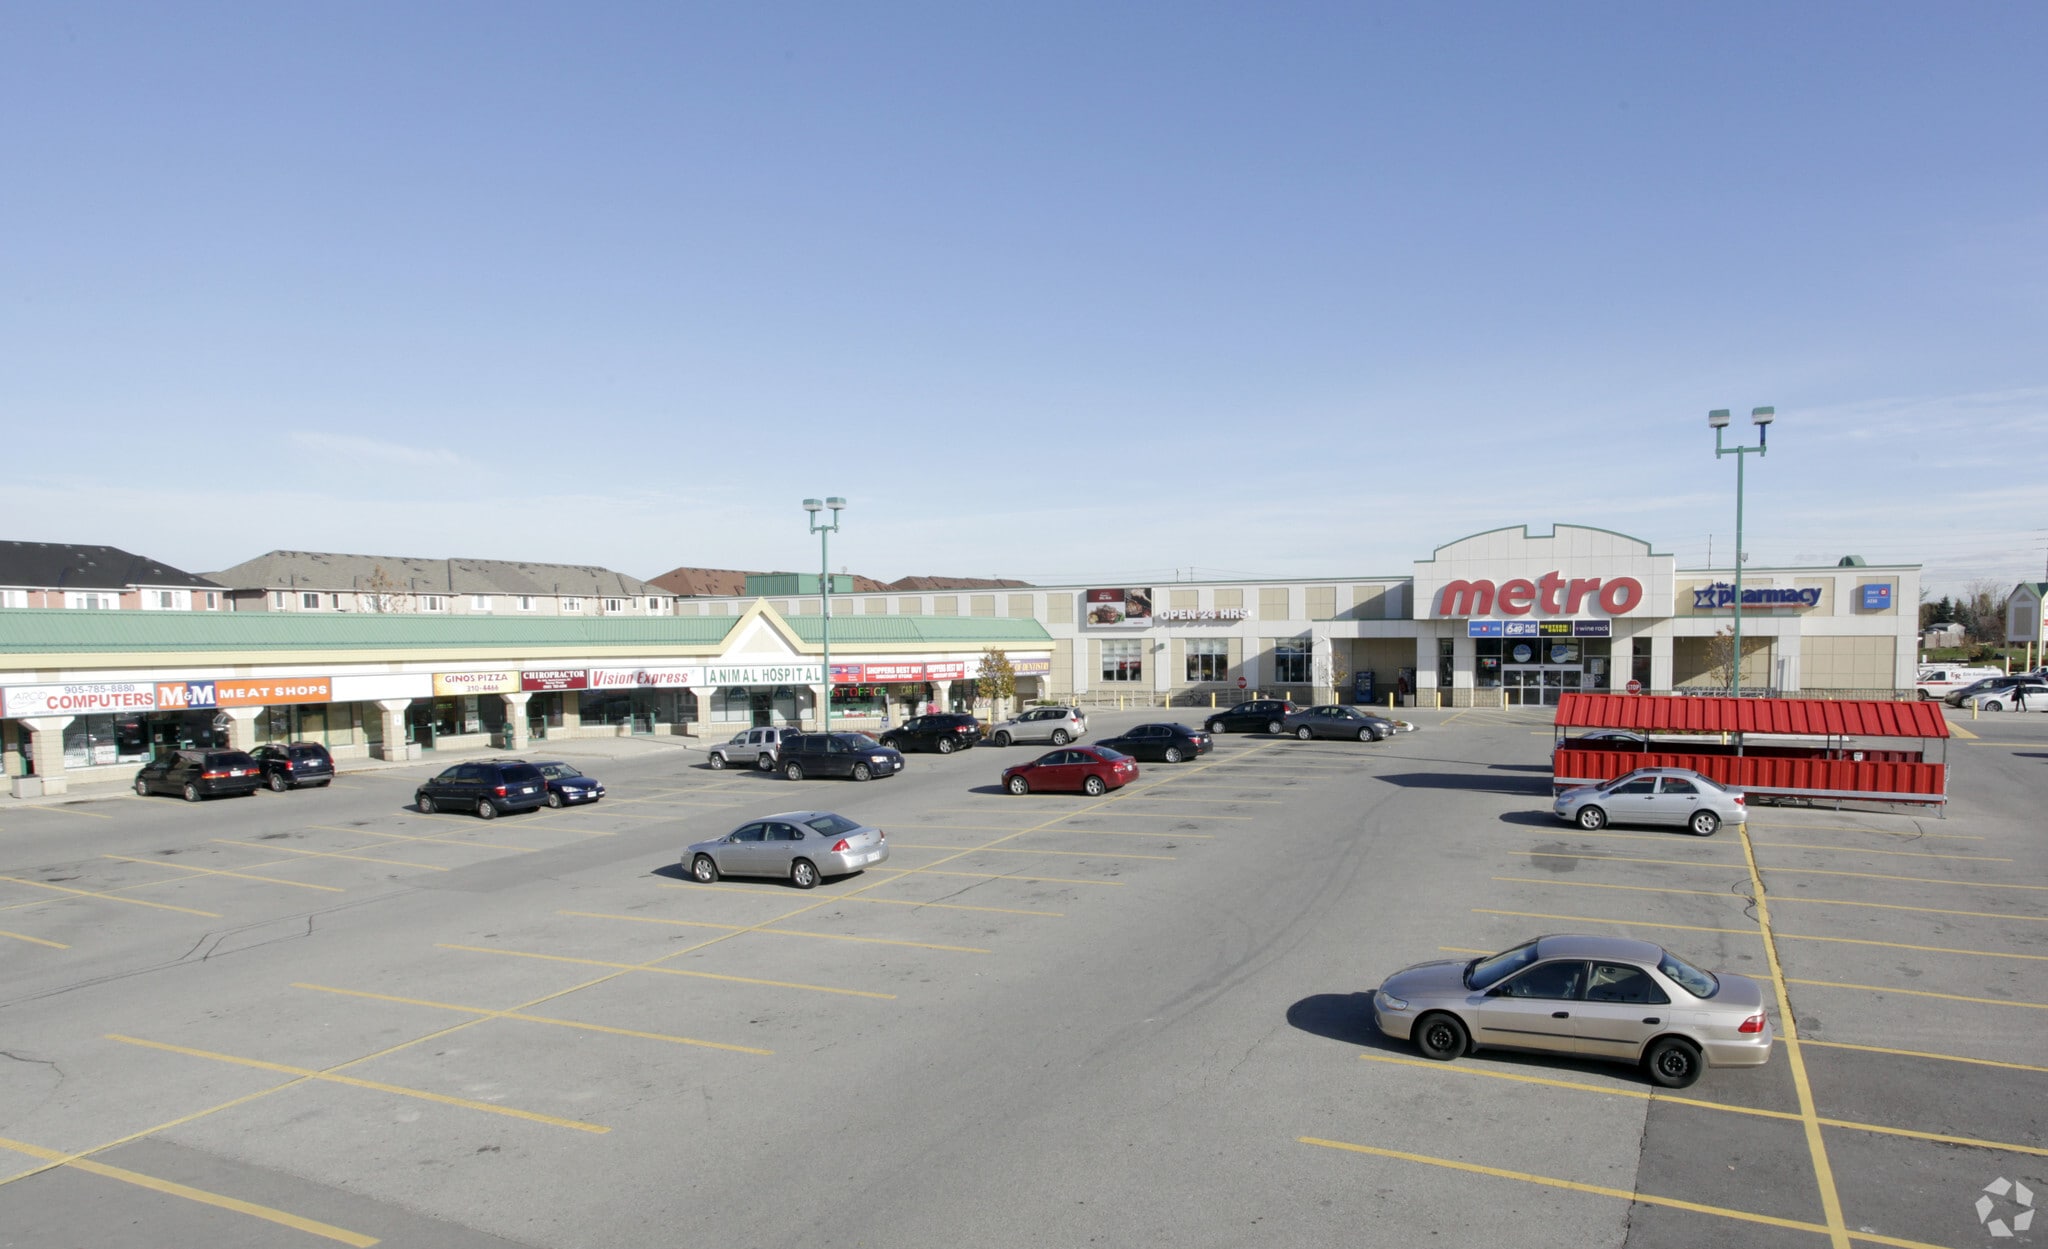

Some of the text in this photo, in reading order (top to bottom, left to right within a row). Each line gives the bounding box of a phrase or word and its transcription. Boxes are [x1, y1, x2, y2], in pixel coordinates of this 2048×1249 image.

[1715, 581, 1729, 589] the
[1439, 570, 1643, 615] metro
[1718, 584, 1822, 608] pharmacy
[1160, 608, 1248, 620] OPEN 24 HRS
[478, 673, 508, 682] PIZZA
[523, 670, 585, 680] CHIROPRACTOR
[593, 670, 688, 687] Vision Express
[709, 668, 758, 683] ANIMAL
[762, 667, 821, 682] HOSPITAL
[64, 684, 135, 695] 905-785-8880
[159, 685, 216, 707] M&M
[220, 685, 328, 699] MEAT SHOPS
[849, 686, 887, 697] OFFICE
[46, 692, 154, 710] COMPUTERS
